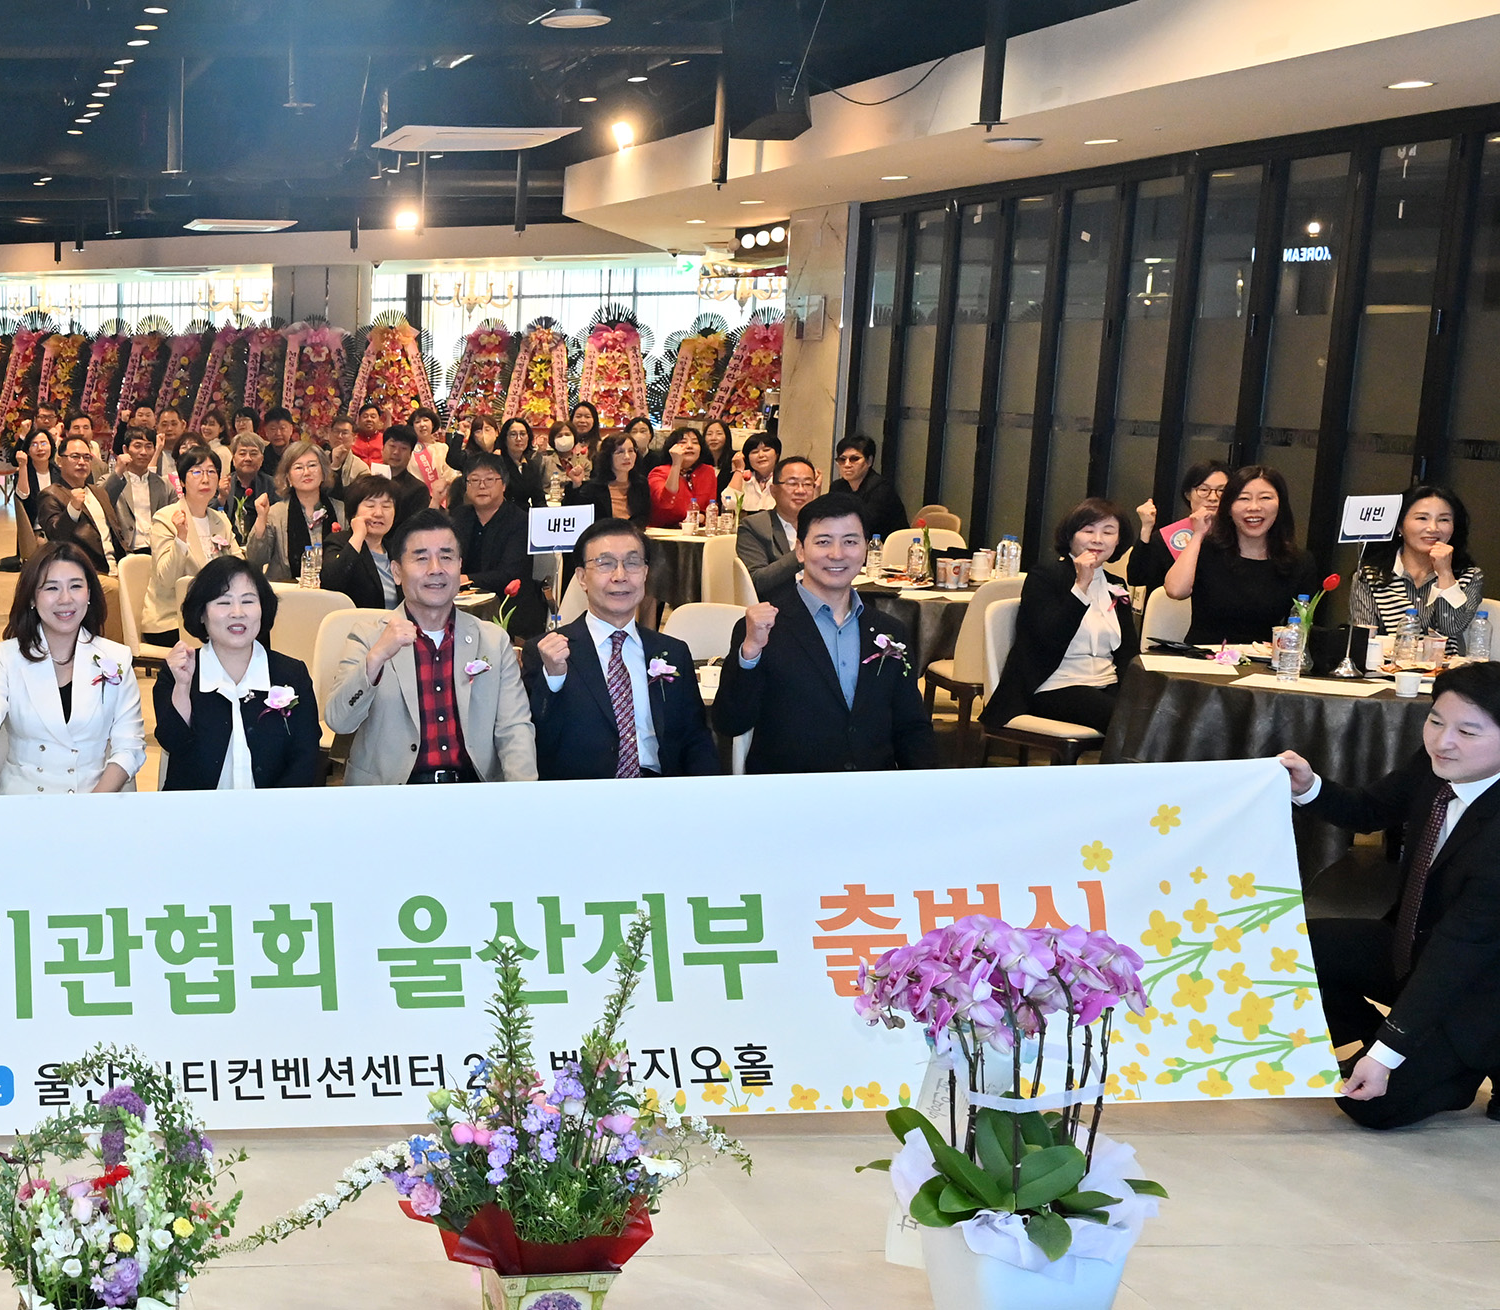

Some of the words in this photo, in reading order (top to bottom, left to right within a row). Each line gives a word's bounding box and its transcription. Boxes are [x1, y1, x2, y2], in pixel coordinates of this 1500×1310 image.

[547, 517, 575, 533] 내빈
[1359, 506, 1386, 522] 내빈
[378, 893, 778, 1009] 울산지부
[34, 1053, 446, 1106] 울산티컨벤션센터
